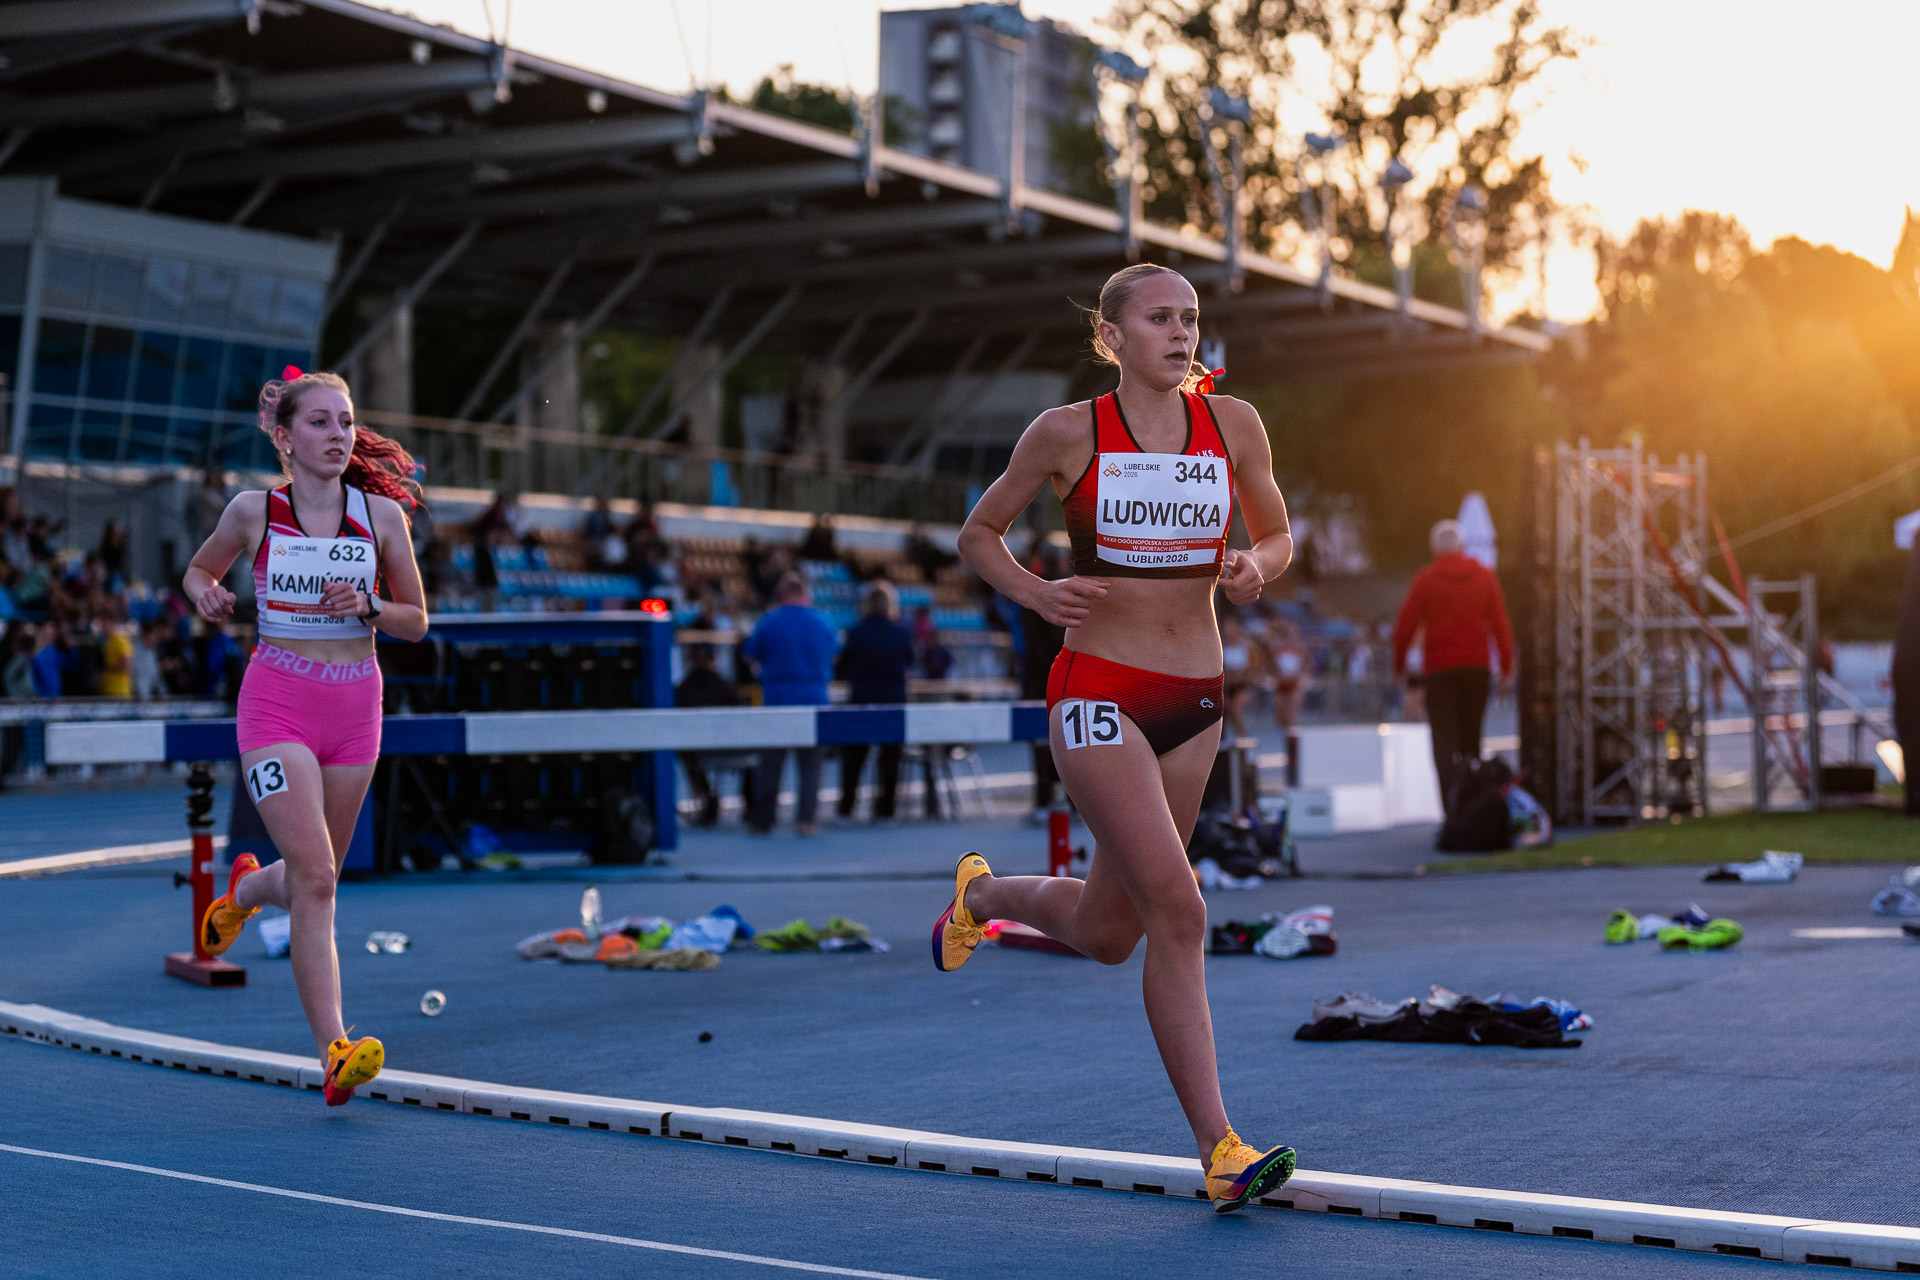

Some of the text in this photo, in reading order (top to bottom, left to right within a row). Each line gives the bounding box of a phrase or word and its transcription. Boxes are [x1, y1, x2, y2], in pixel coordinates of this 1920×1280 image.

[1124, 463, 1161, 471] LUBELSKIE
[1175, 461, 1217, 484] 344
[1102, 499, 1221, 528] LUDWICKA
[1117, 538, 1162, 546] OGÓLNOPOLSKA
[329, 544, 366, 562] 632
[1126, 553, 1189, 564] LUBLIN 2026
[290, 615, 322, 624] LUBLIN
[261, 645, 314, 674] PRO
[321, 658, 374, 681] NIKE
[1065, 704, 1119, 744] 15
[250, 761, 284, 798] 13
